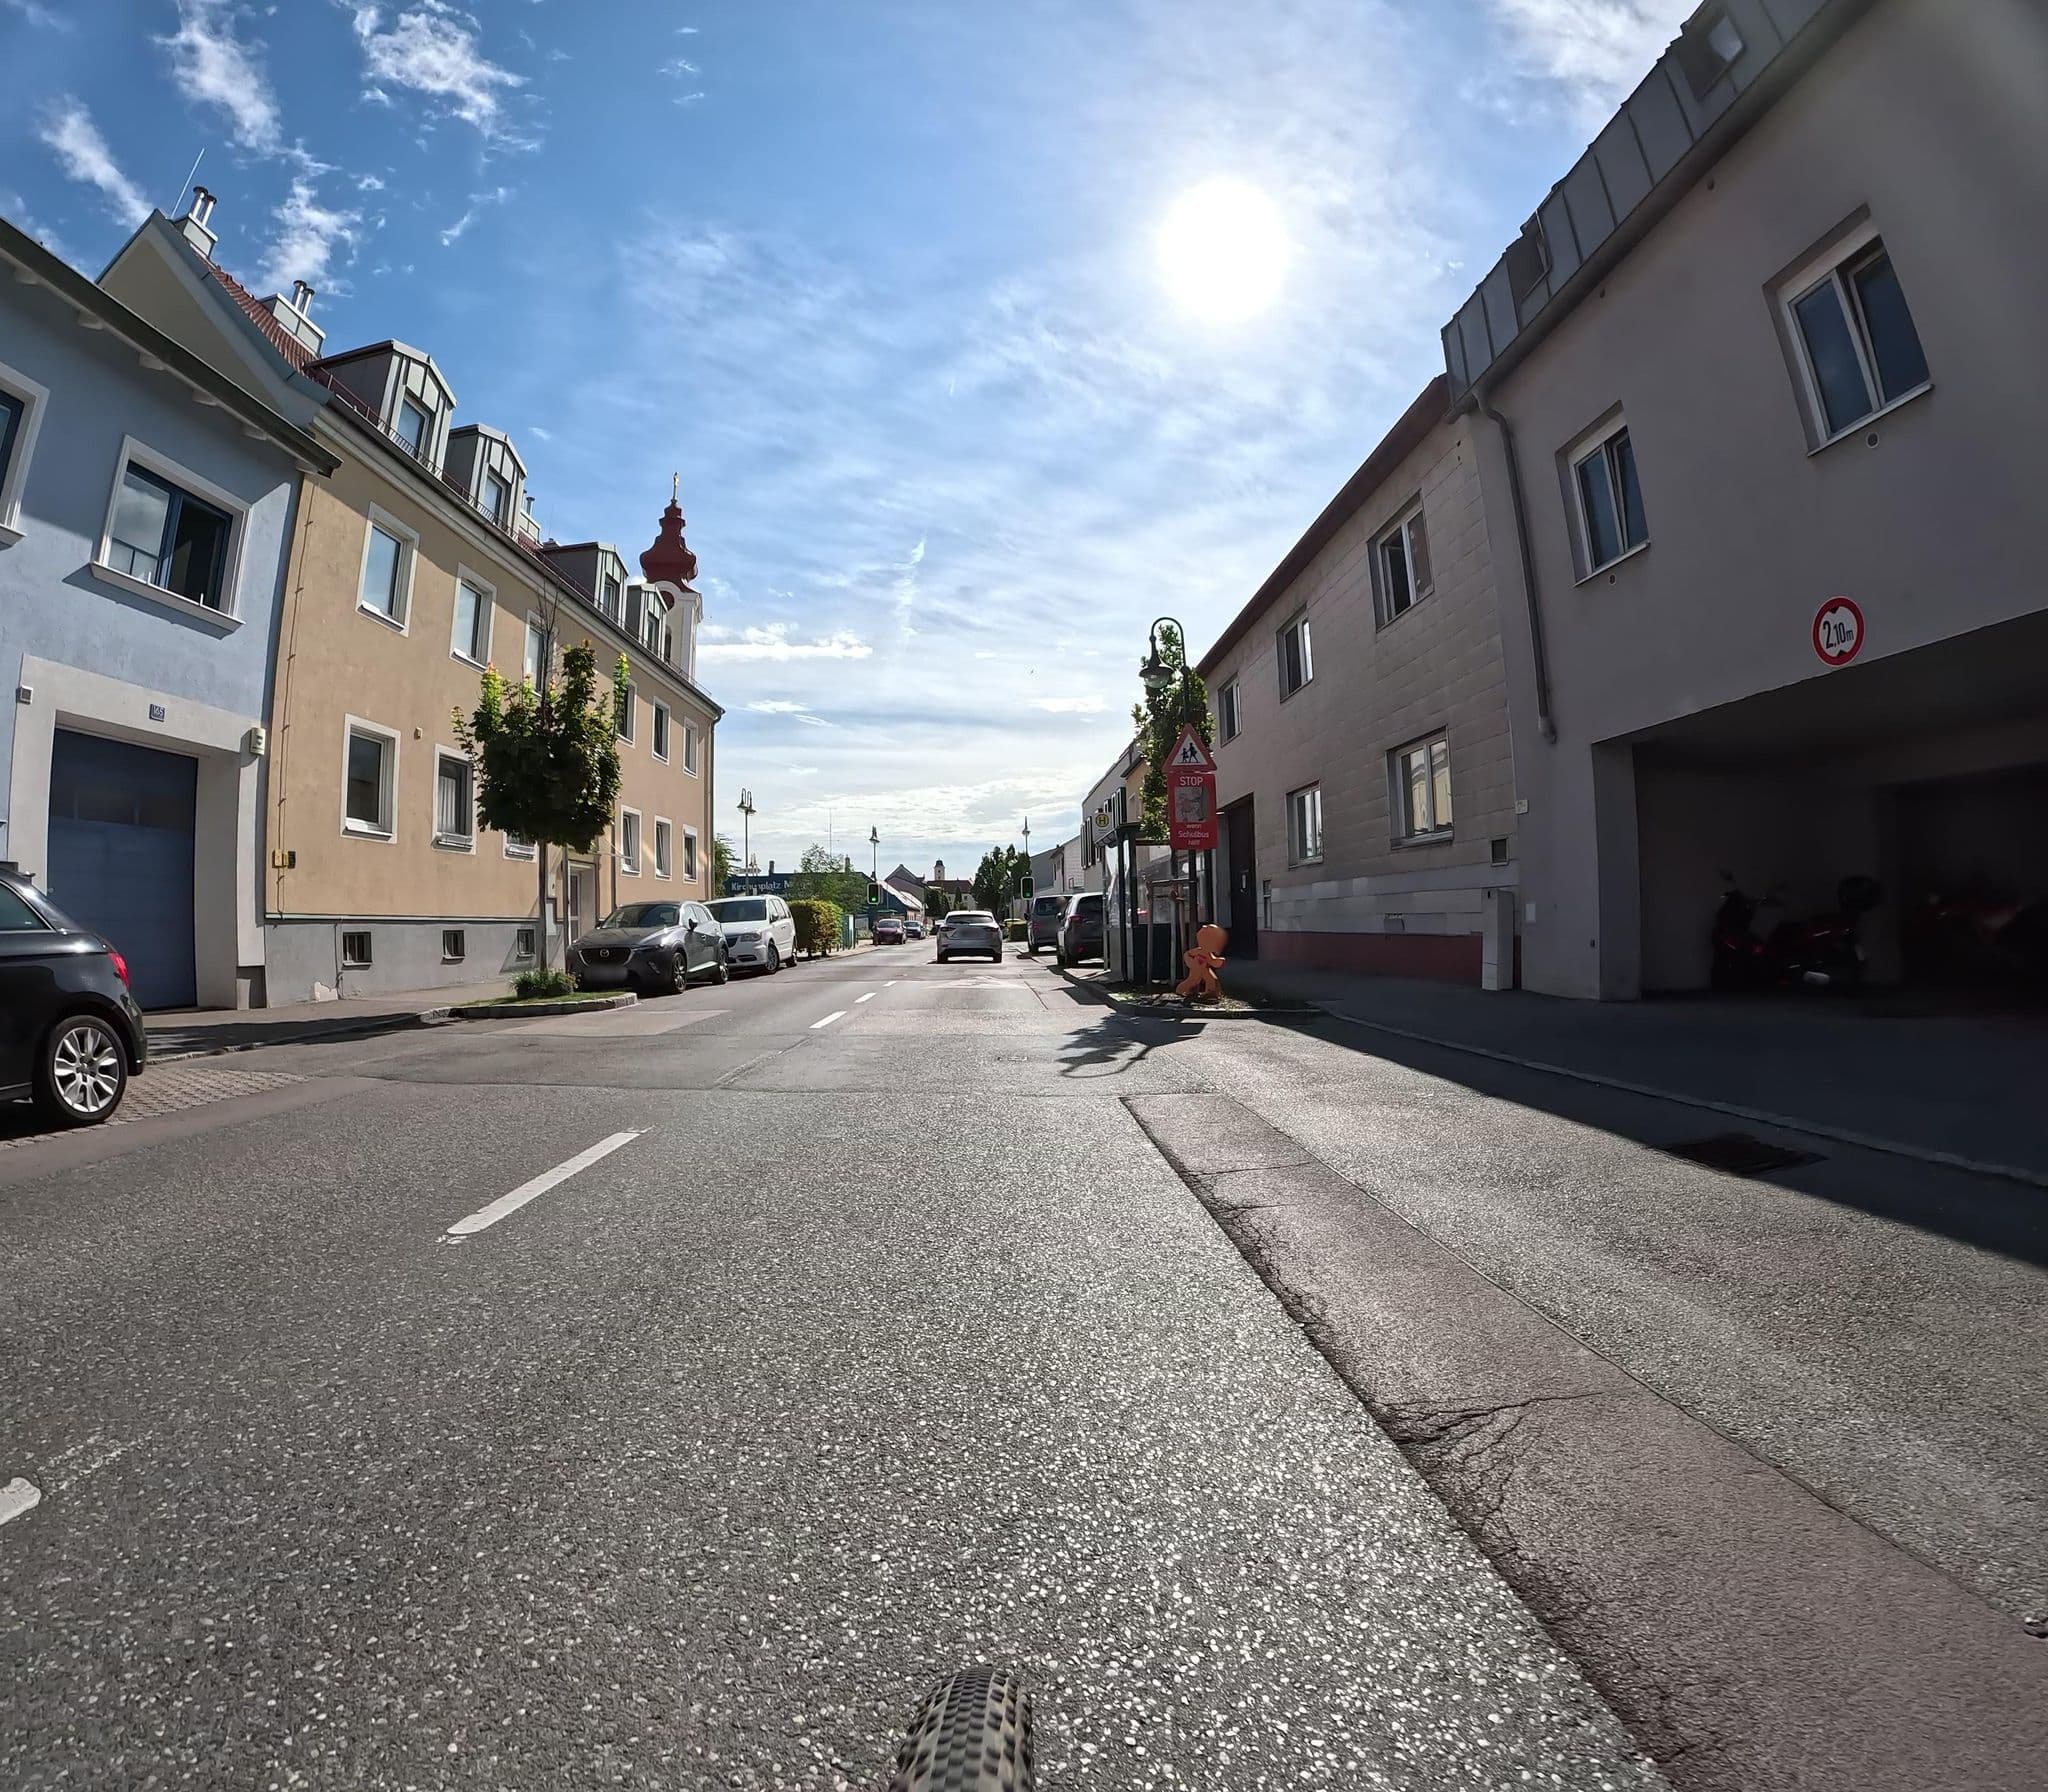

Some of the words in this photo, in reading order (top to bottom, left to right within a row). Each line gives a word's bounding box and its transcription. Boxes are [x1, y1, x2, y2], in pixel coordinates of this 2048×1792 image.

[1180, 776, 1204, 786] STOP
[1098, 816, 1107, 825] H
[1178, 830, 1209, 838] Schulbus
